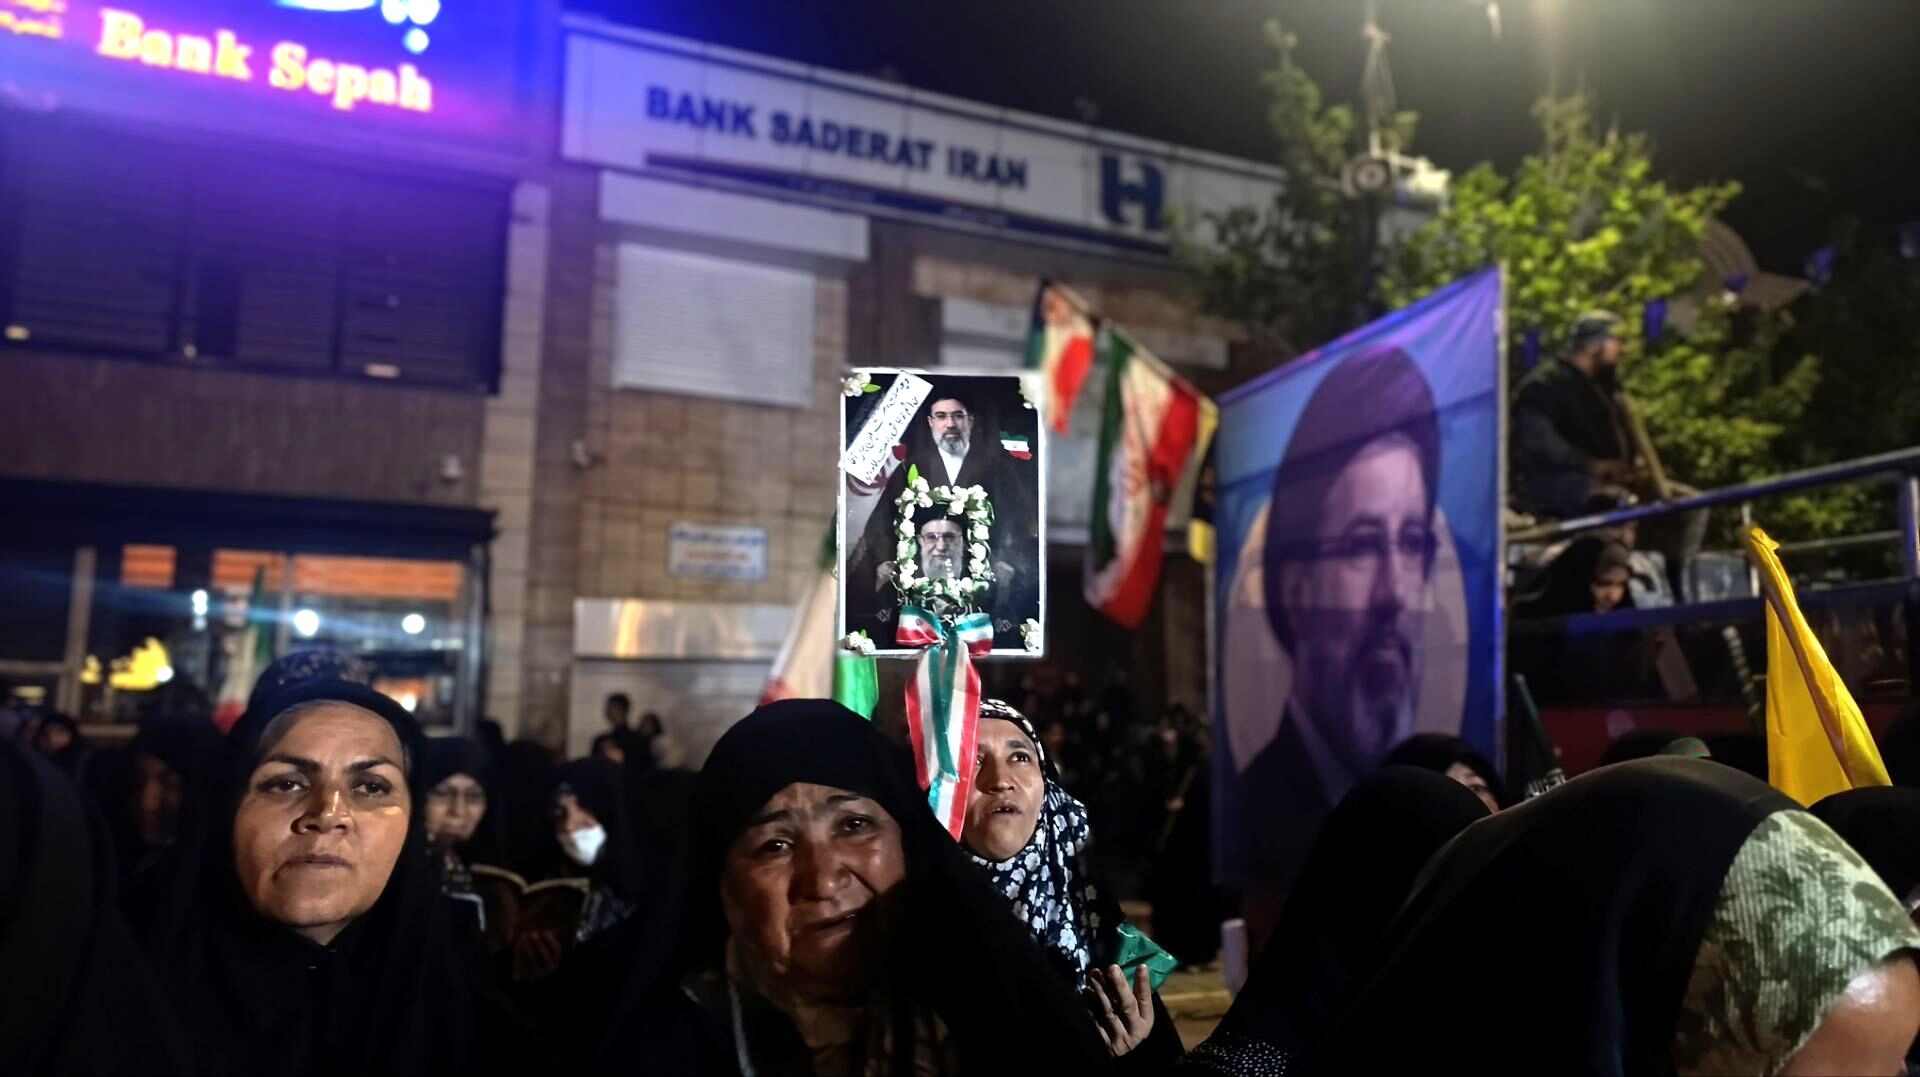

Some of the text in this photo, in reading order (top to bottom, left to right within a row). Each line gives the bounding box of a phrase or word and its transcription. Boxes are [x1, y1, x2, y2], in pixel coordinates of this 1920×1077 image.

[98, 9, 252, 80] Bank
[269, 42, 432, 111] Sepah
[646, 86, 1027, 189] BANK SADERAT IRAN
